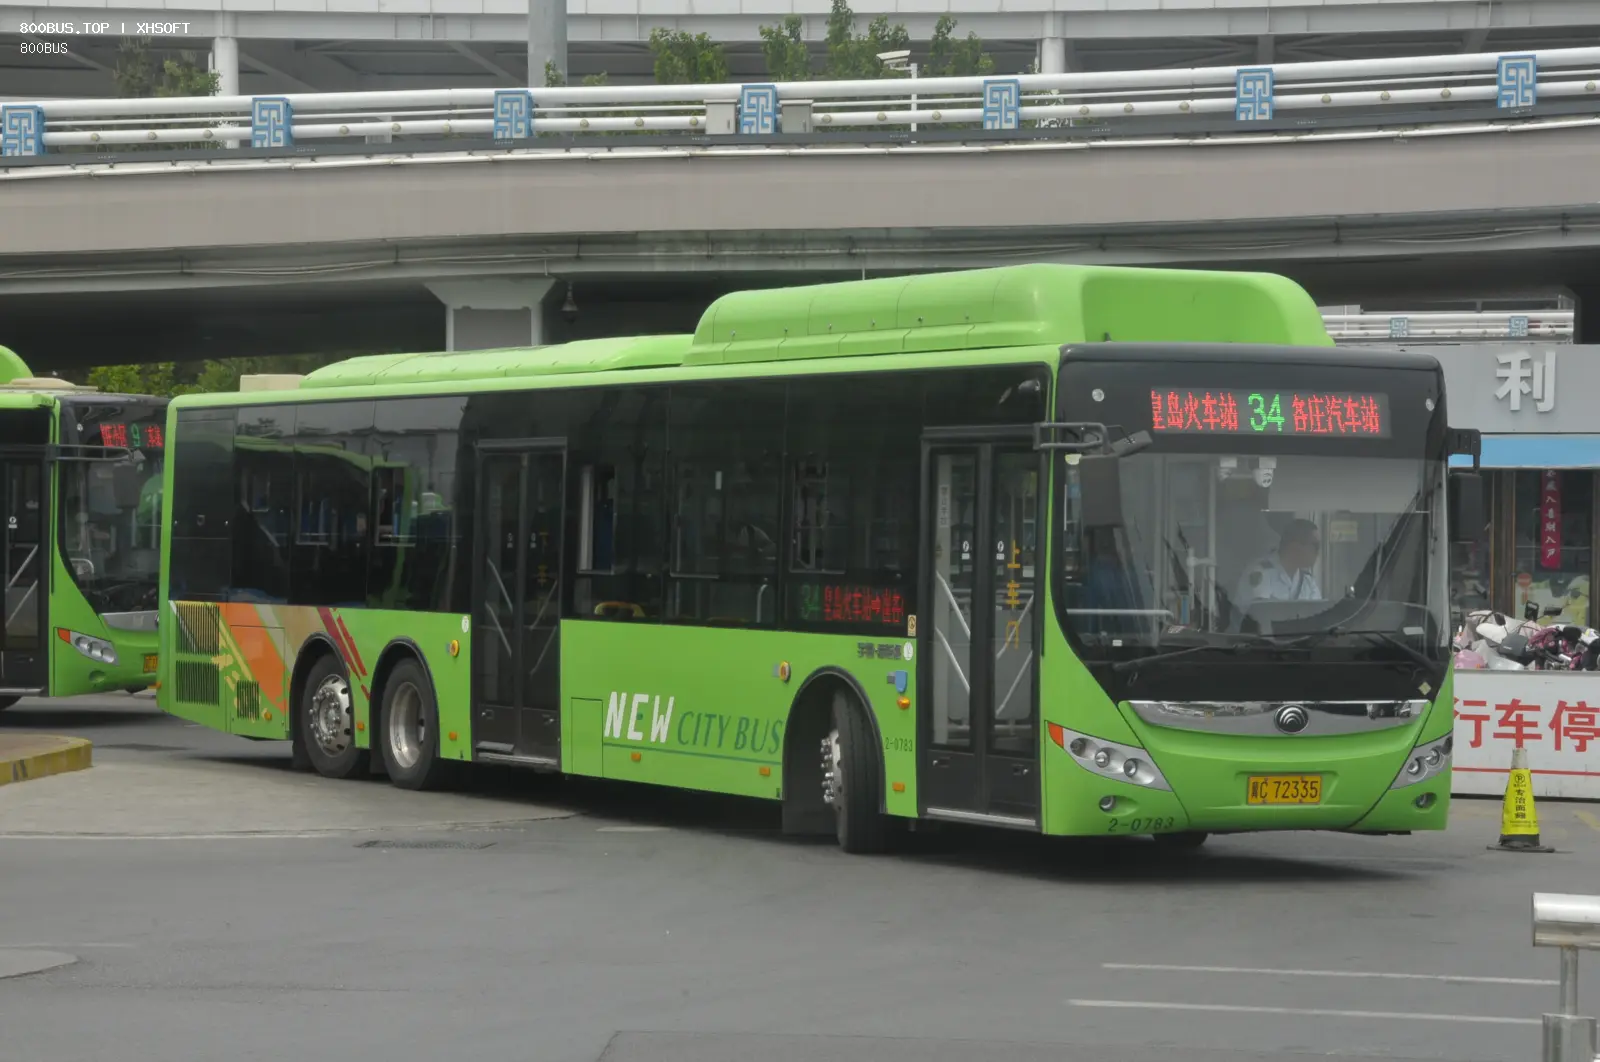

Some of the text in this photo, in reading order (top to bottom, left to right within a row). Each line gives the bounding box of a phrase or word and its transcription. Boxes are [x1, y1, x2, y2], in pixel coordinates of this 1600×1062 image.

[1494, 350, 1557, 412] 利
[1248, 392, 1285, 432] 34
[131, 423, 141, 447] 9
[604, 691, 785, 755] NEW CITY BUS
[885, 736, 913, 752] 2-0783
[1273, 780, 1319, 799] 72335
[1107, 816, 1175, 832] 2-0783
